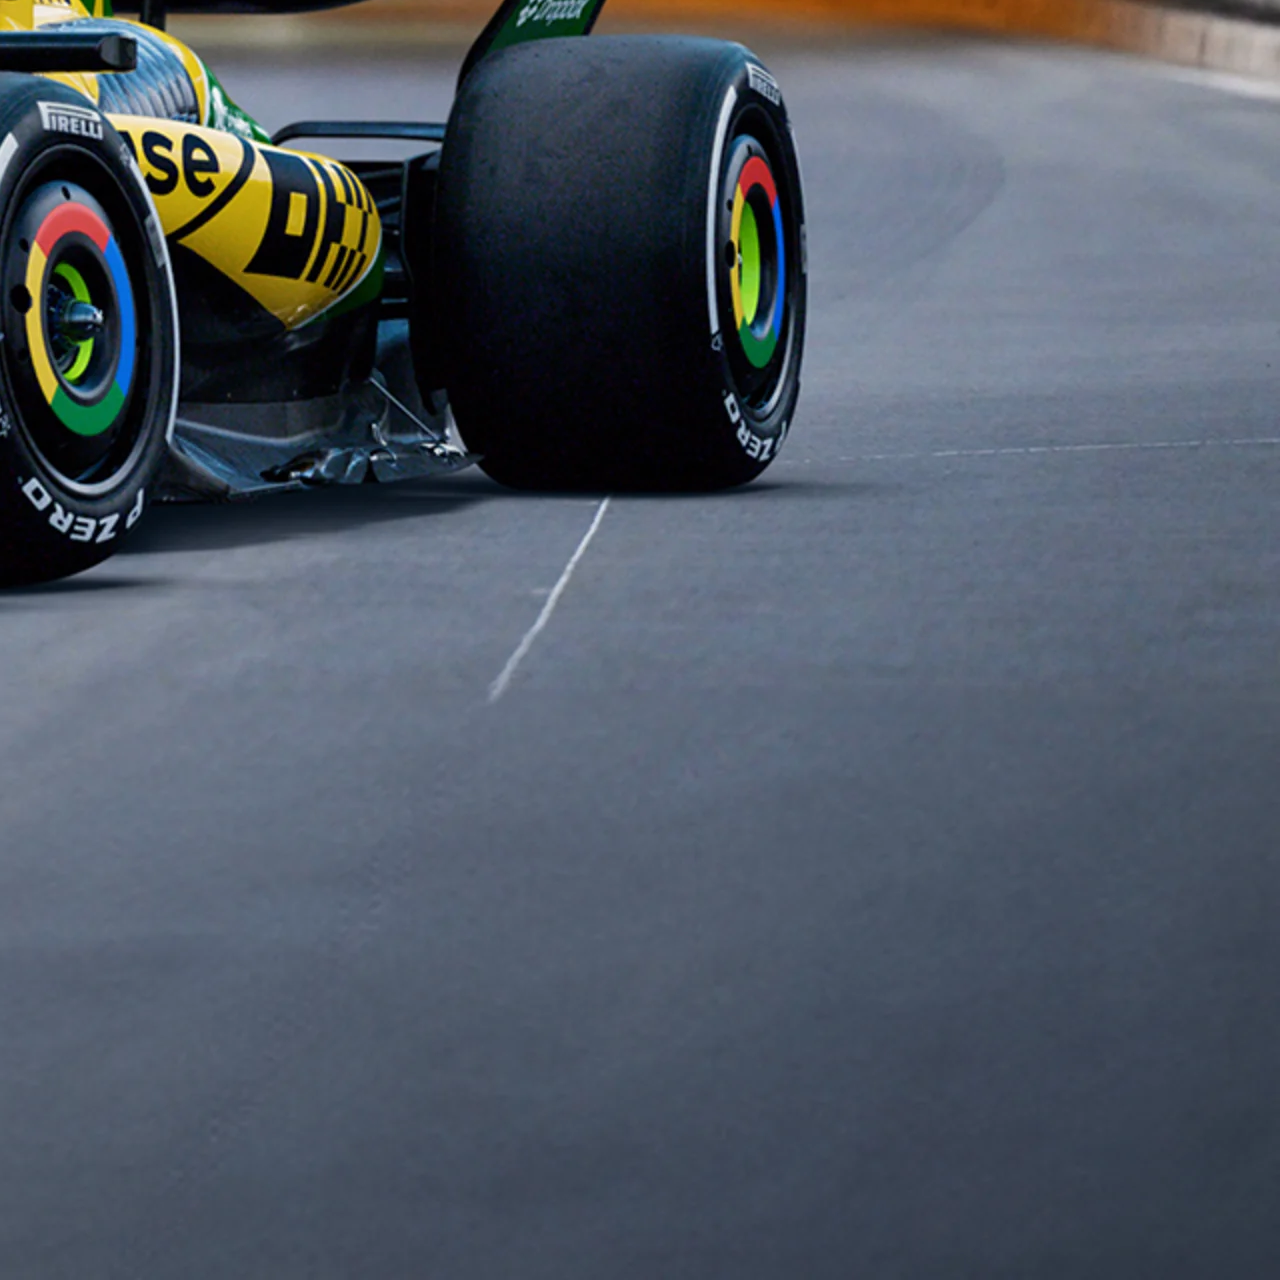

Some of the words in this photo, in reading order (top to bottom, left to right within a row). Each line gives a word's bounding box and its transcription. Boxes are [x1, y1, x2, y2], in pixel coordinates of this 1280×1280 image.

[36, 100, 104, 141] PIRELLI
[724, 392, 774, 462] ZERO
[21, 477, 120, 544] ZERO
